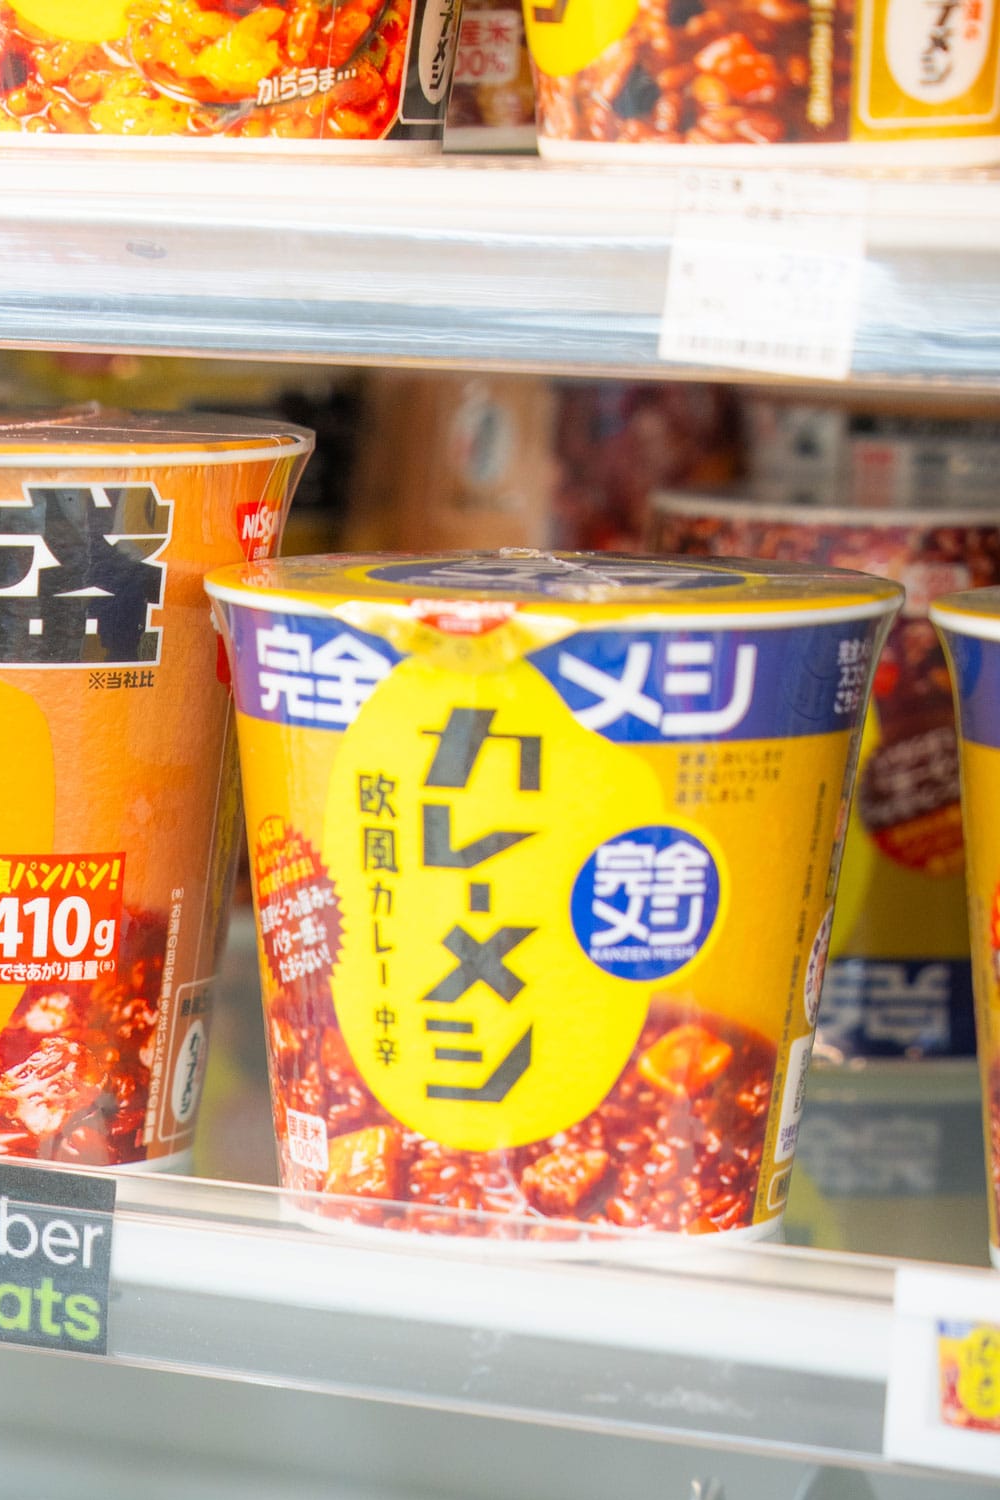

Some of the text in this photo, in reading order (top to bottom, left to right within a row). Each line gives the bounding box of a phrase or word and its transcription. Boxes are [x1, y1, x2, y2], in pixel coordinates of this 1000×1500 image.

[88, 669, 156, 691] ※当社比
[593, 839, 710, 898] 完全
[357, 771, 399, 1068] 欧風カレー 中辛
[420, 705, 543, 1103] カレーメシ
[589, 893, 705, 947] メシ
